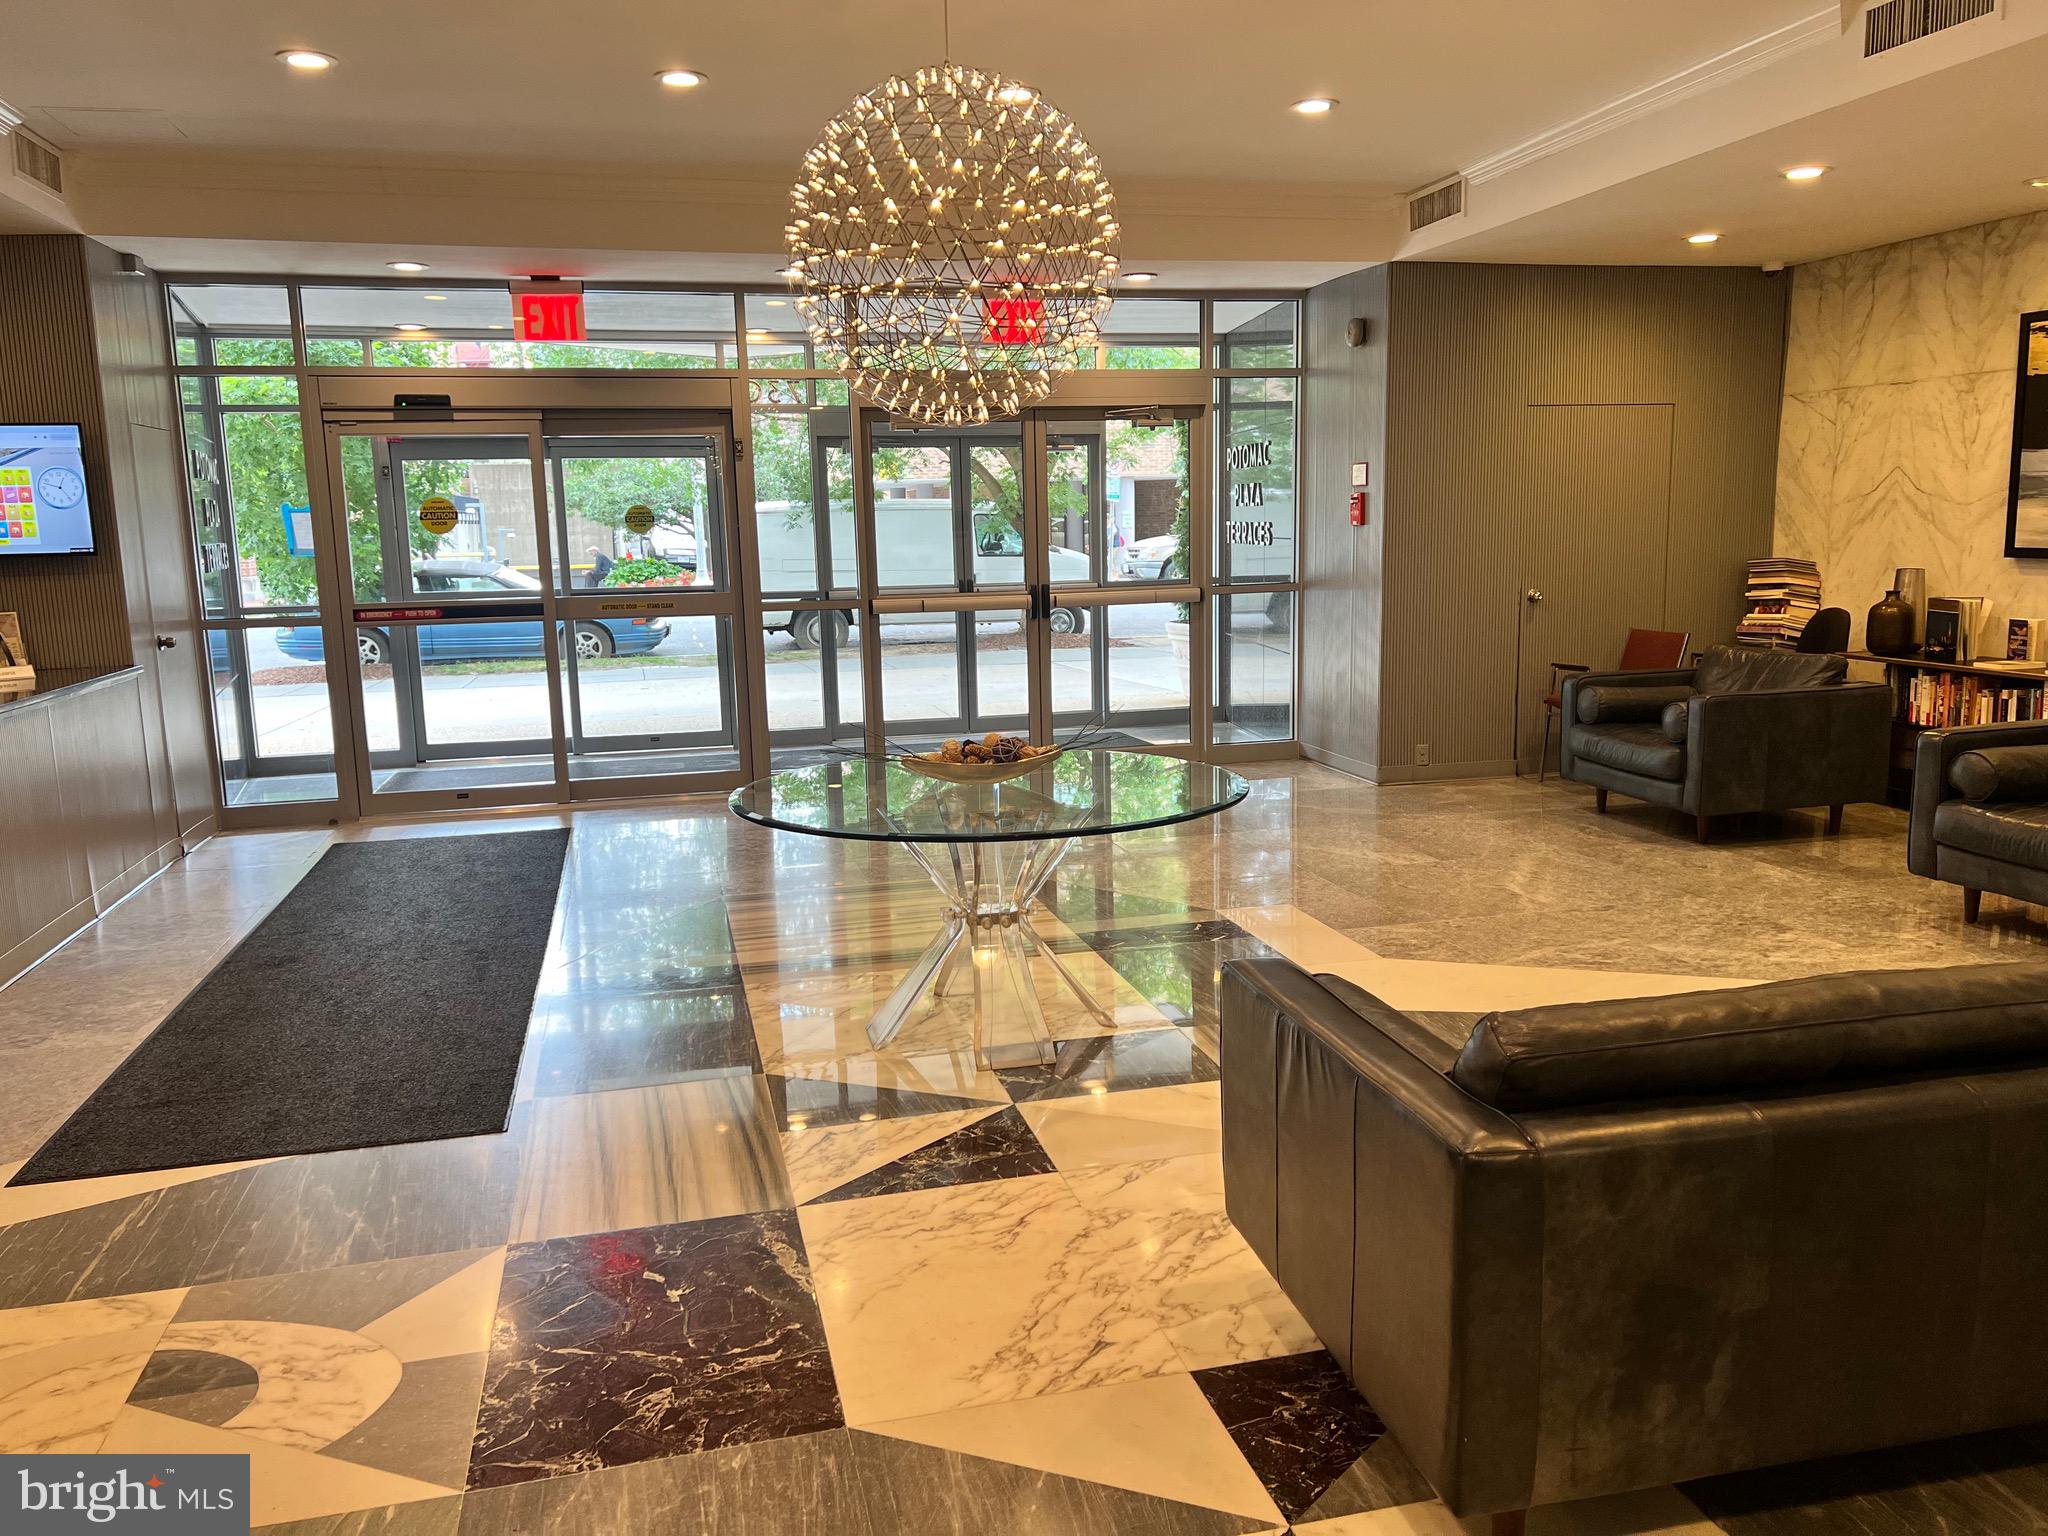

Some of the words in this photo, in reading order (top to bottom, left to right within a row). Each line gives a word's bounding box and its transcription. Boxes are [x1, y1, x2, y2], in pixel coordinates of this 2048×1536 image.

[521, 294, 579, 341] EXIT
[1226, 440, 1271, 471] POTOMAC
[1235, 482, 1263, 506] PLAZA
[421, 512, 457, 520] CAUTION
[1226, 520, 1273, 546] TERRACES
